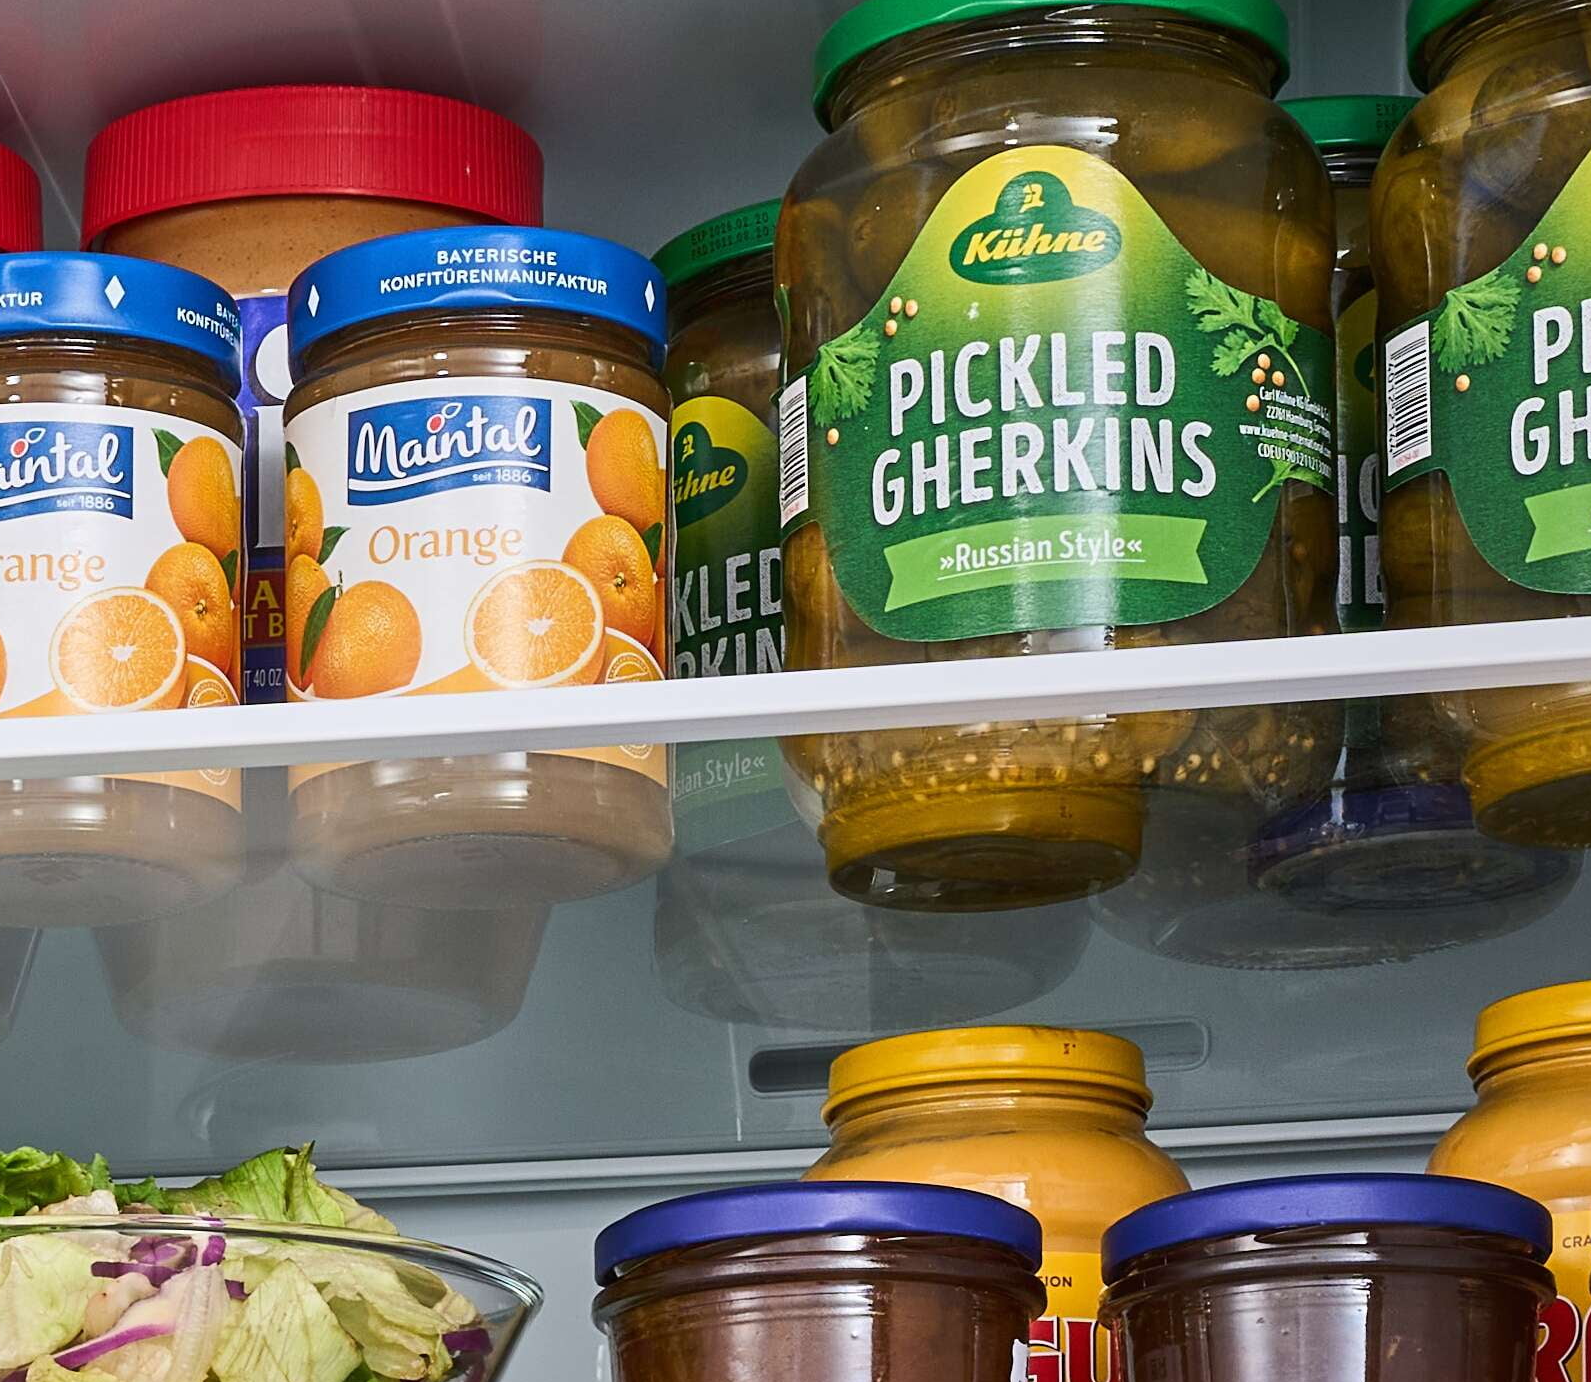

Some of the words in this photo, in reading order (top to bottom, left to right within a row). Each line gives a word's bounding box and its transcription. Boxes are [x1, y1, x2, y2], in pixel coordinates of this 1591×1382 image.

[436, 248, 558, 267] BAYERISCHE
[962, 223, 1109, 266] Kühne
[380, 268, 608, 296] KONFITÜRENMANUFAKTUR
[889, 330, 1176, 438] PICKLED
[355, 404, 541, 478] Maintal
[472, 470, 491, 483] seit
[495, 468, 531, 485] 1886
[673, 463, 736, 506] ühne
[872, 418, 1217, 527] GHERKINS
[56, 497, 75, 509] seit
[79, 494, 114, 511] 1886
[368, 522, 524, 567] Orange
[253, 669, 266, 687] 40
[269, 668, 282, 686] OZ
